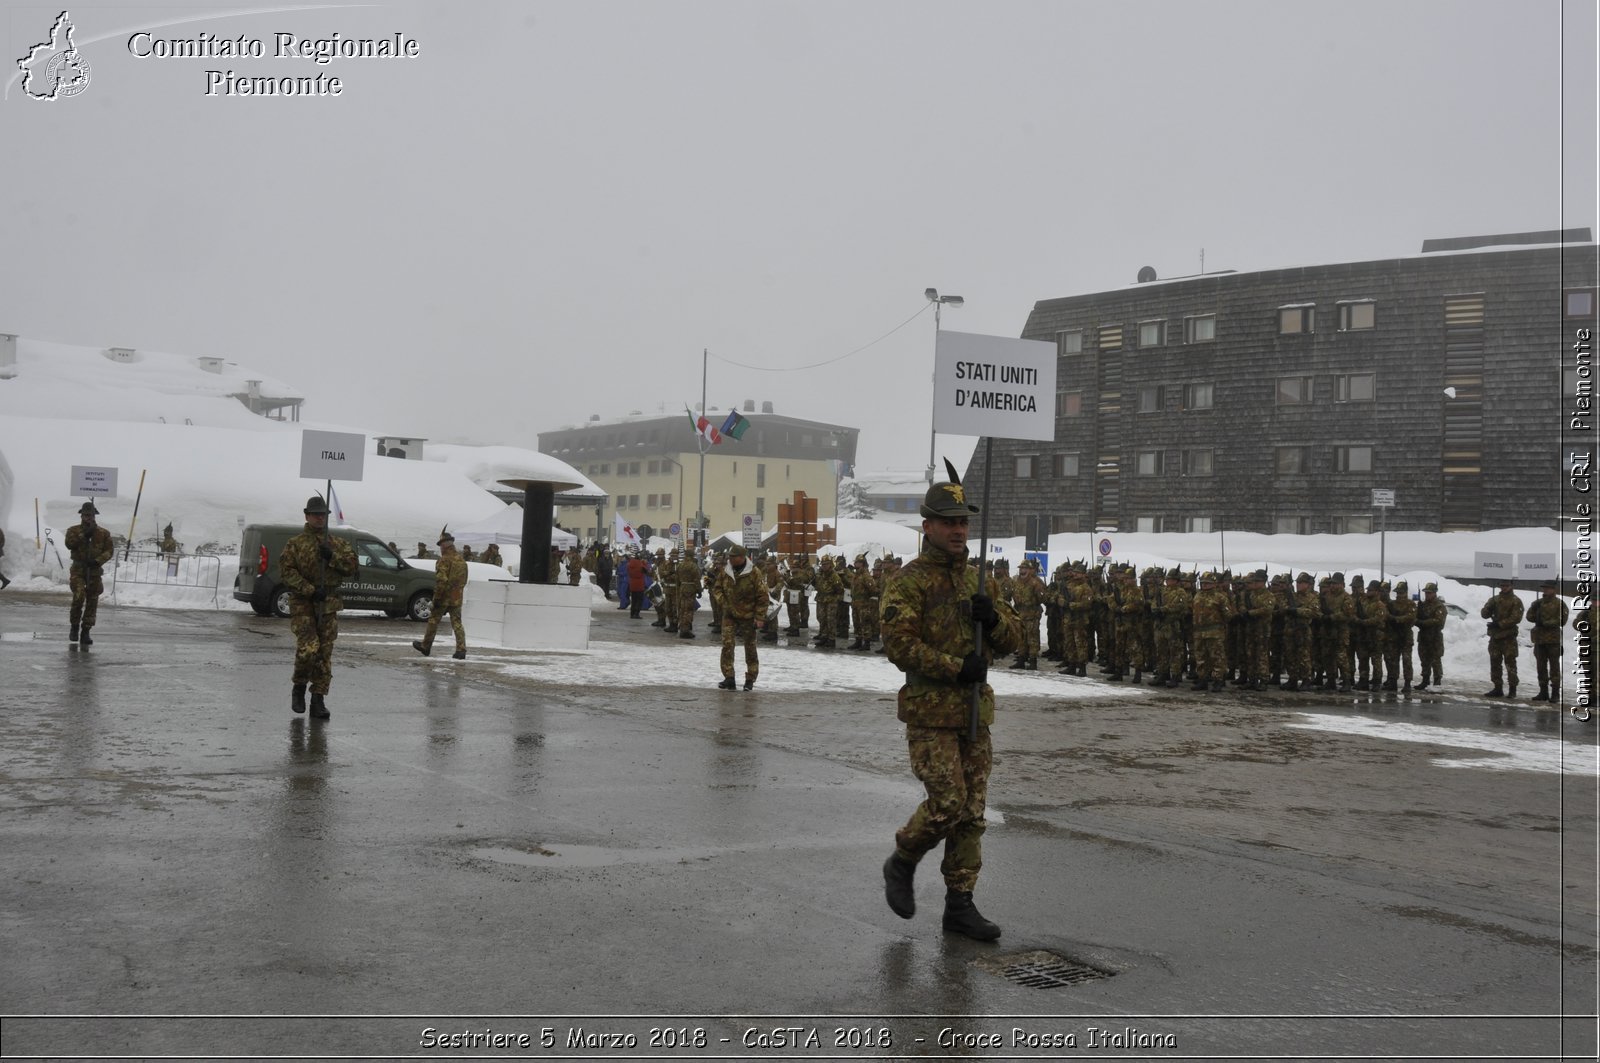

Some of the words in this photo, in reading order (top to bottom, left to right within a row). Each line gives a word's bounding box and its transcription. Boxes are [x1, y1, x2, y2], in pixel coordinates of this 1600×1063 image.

[955, 361, 996, 382] STATI
[1000, 365, 1038, 386] UNITI
[955, 388, 1037, 413] D'AMERICA
[321, 450, 346, 461] ITALIA
[338, 581, 360, 590] CITO
[360, 582, 396, 591] ITALIANO
